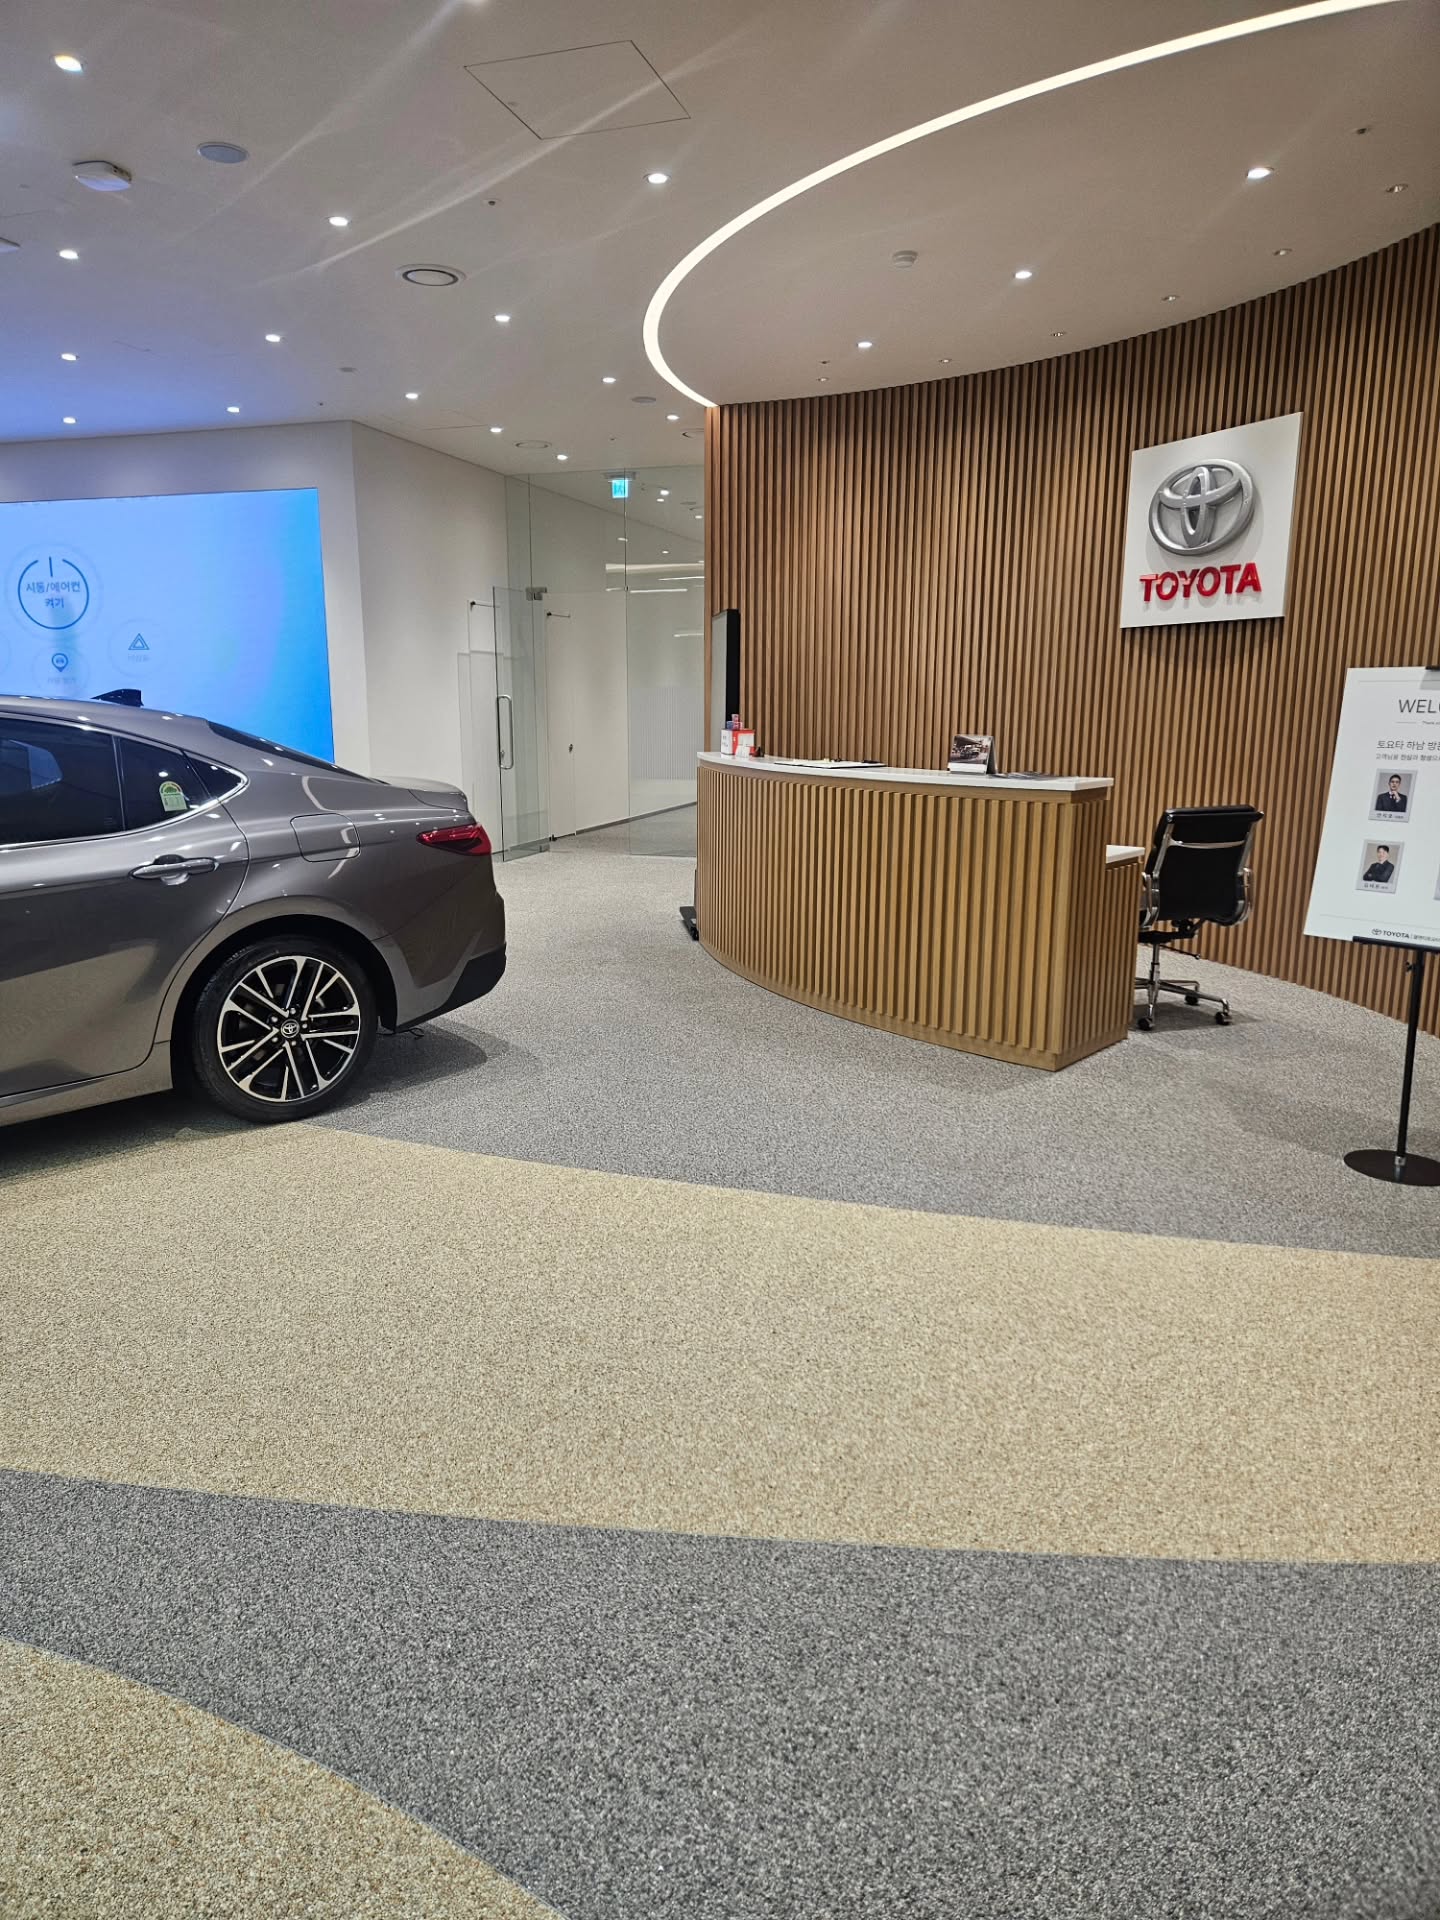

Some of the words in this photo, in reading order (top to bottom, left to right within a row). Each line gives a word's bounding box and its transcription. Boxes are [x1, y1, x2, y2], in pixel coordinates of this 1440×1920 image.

[26, 581, 81, 593] 시동/에어컨
[1139, 562, 1262, 602] TOYOTA
[44, 597, 65, 609] 켜기
[1398, 698, 1440, 714] WEL
[1376, 740, 1404, 750] 토요타
[1406, 740, 1426, 751] 하남
[1383, 930, 1409, 939] TOYOTA
